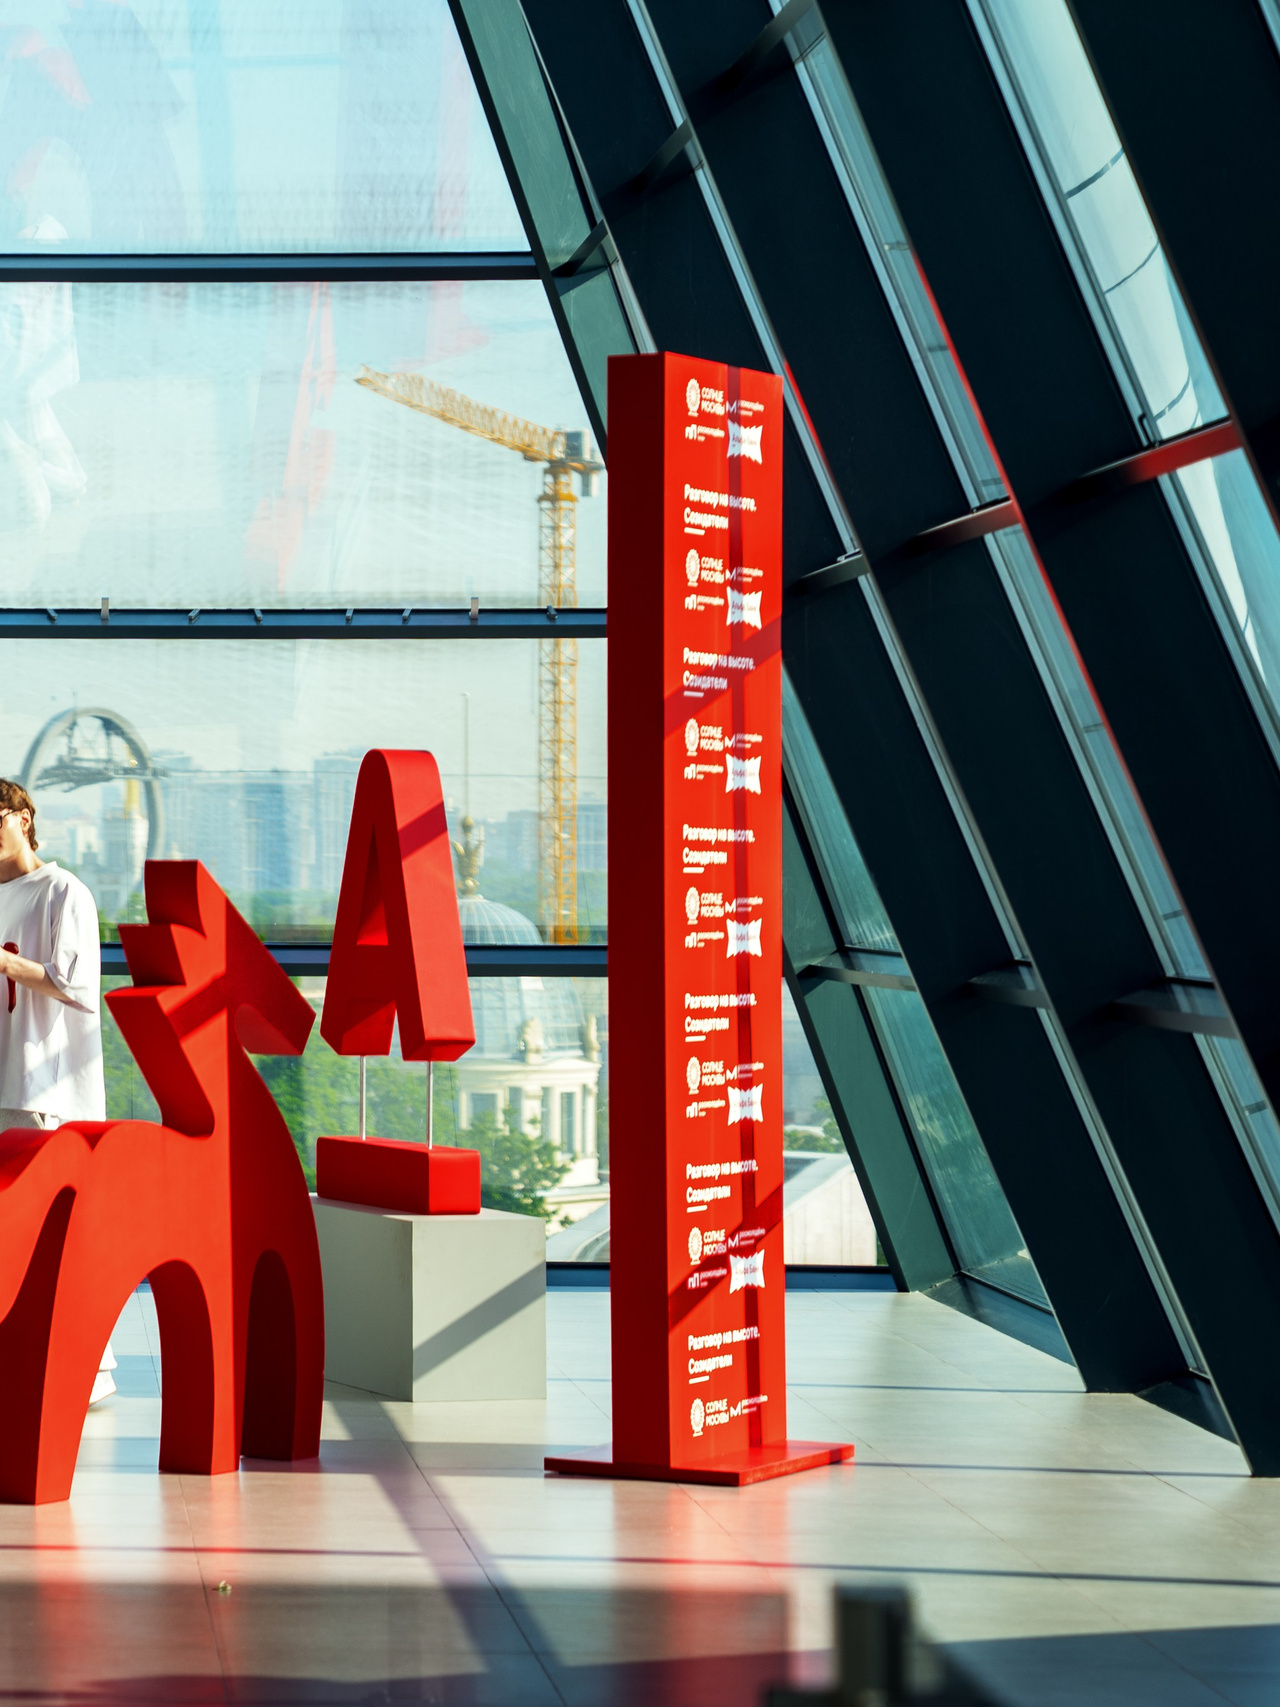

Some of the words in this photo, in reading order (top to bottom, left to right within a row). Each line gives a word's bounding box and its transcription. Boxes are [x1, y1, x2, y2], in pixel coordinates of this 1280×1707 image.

[684, 484, 718, 509] Разговор
[719, 494, 728, 507] на
[729, 494, 757, 512] высоте.
[684, 507, 729, 529] Созидатели
[683, 647, 717, 671] Разговор
[718, 655, 727, 667] на
[728, 655, 755, 671] высоте.
[683, 670, 728, 690] Созидатели
[683, 824, 717, 845] Разговор
[717, 828, 727, 841] на
[727, 828, 755, 843] высоте.
[683, 847, 727, 865] Созидатели
[685, 993, 719, 1012] Разговор
[719, 994, 729, 1008] на
[729, 993, 757, 1007] высоте.
[685, 1016, 729, 1033] Созидатели
[686, 1163, 720, 1180] Разговор
[721, 1162, 730, 1176] на
[730, 1159, 758, 1175] высоте.
[686, 1185, 731, 1204] Созидатели
[688, 1333, 722, 1351] Разговор
[723, 1331, 732, 1345] на
[732, 1326, 760, 1343] высоте.
[688, 1353, 733, 1375] Созидатели
